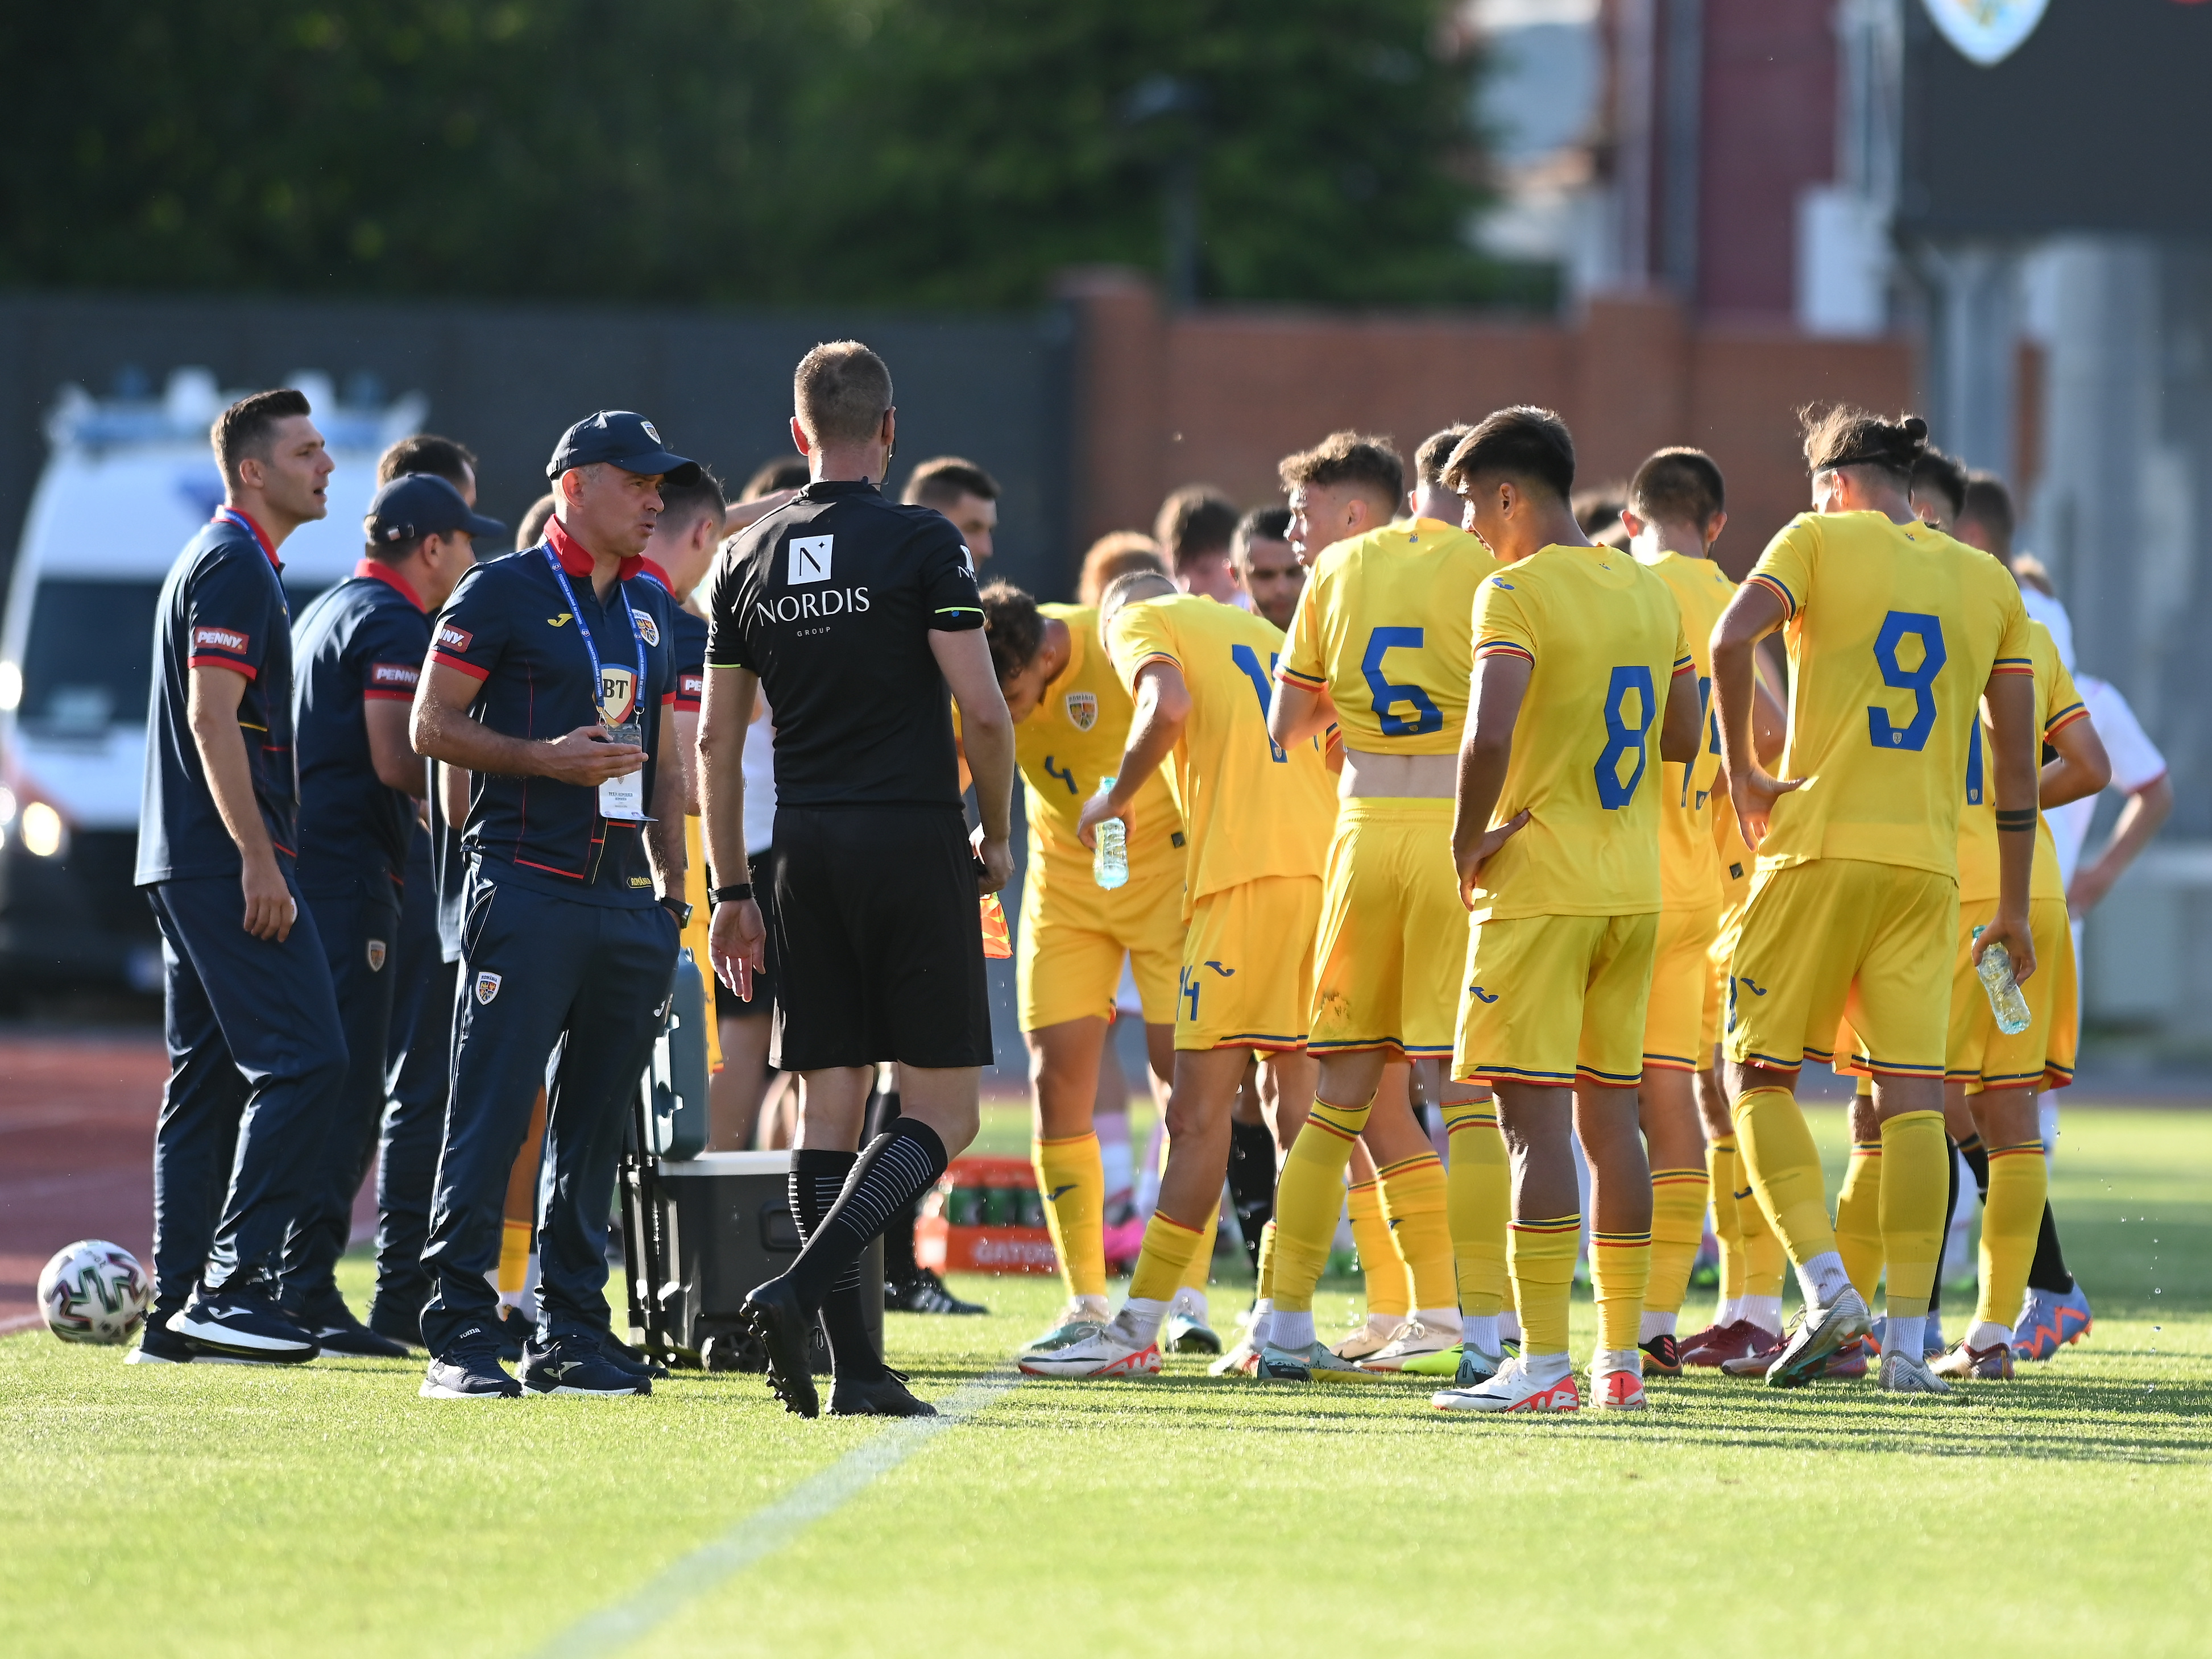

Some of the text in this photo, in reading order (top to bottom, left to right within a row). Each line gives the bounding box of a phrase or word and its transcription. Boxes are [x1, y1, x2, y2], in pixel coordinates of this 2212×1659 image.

[756, 587, 870, 627] NORDIS
[797, 626, 831, 637] GROUP
[603, 678, 628, 699] BT
[1361, 627, 1443, 736] 6
[1867, 610, 1948, 752] 9
[1594, 666, 1656, 810] 8
[1045, 756, 1079, 794] 4
